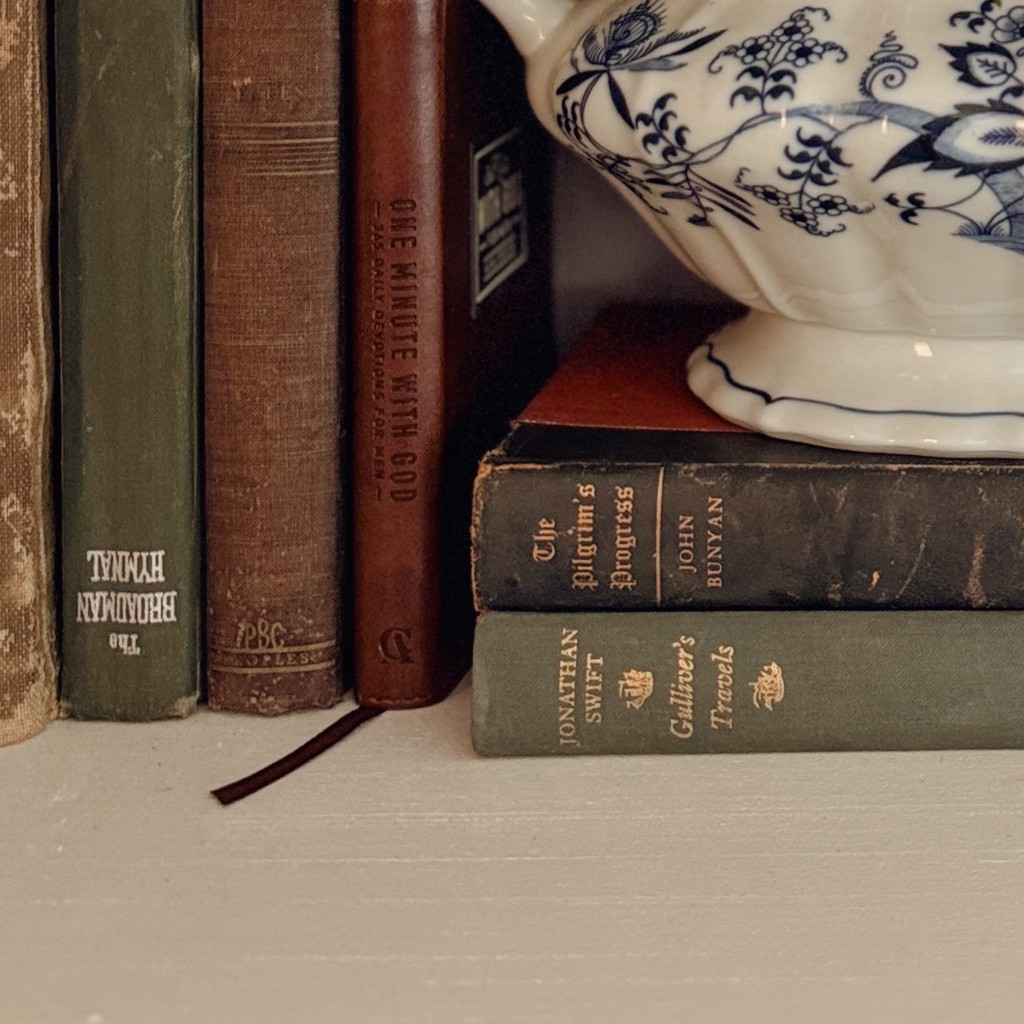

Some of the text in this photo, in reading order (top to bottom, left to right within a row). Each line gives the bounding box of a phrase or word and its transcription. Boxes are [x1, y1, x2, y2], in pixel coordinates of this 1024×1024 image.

[372, 223, 385, 480] 365 DAILY DEVOTIONS FOR MEN
[389, 199, 418, 503] ONE MINUTE WITH GOD
[86, 549, 166, 584] HYMNAL
[532, 517, 560, 563] The
[571, 482, 599, 591] Pilgrim's
[610, 485, 637, 591] Progress
[679, 515, 697, 573] JOHN
[707, 496, 723, 588] BUNYAN
[76, 590, 178, 624] BROADMAN
[108, 632, 141, 656] The
[221, 650, 310, 668] OPLES
[558, 628, 581, 747] JONATHAN
[586, 653, 604, 723] SWIFT
[670, 635, 696, 739] Gulliver's
[711, 645, 735, 730] Travels
